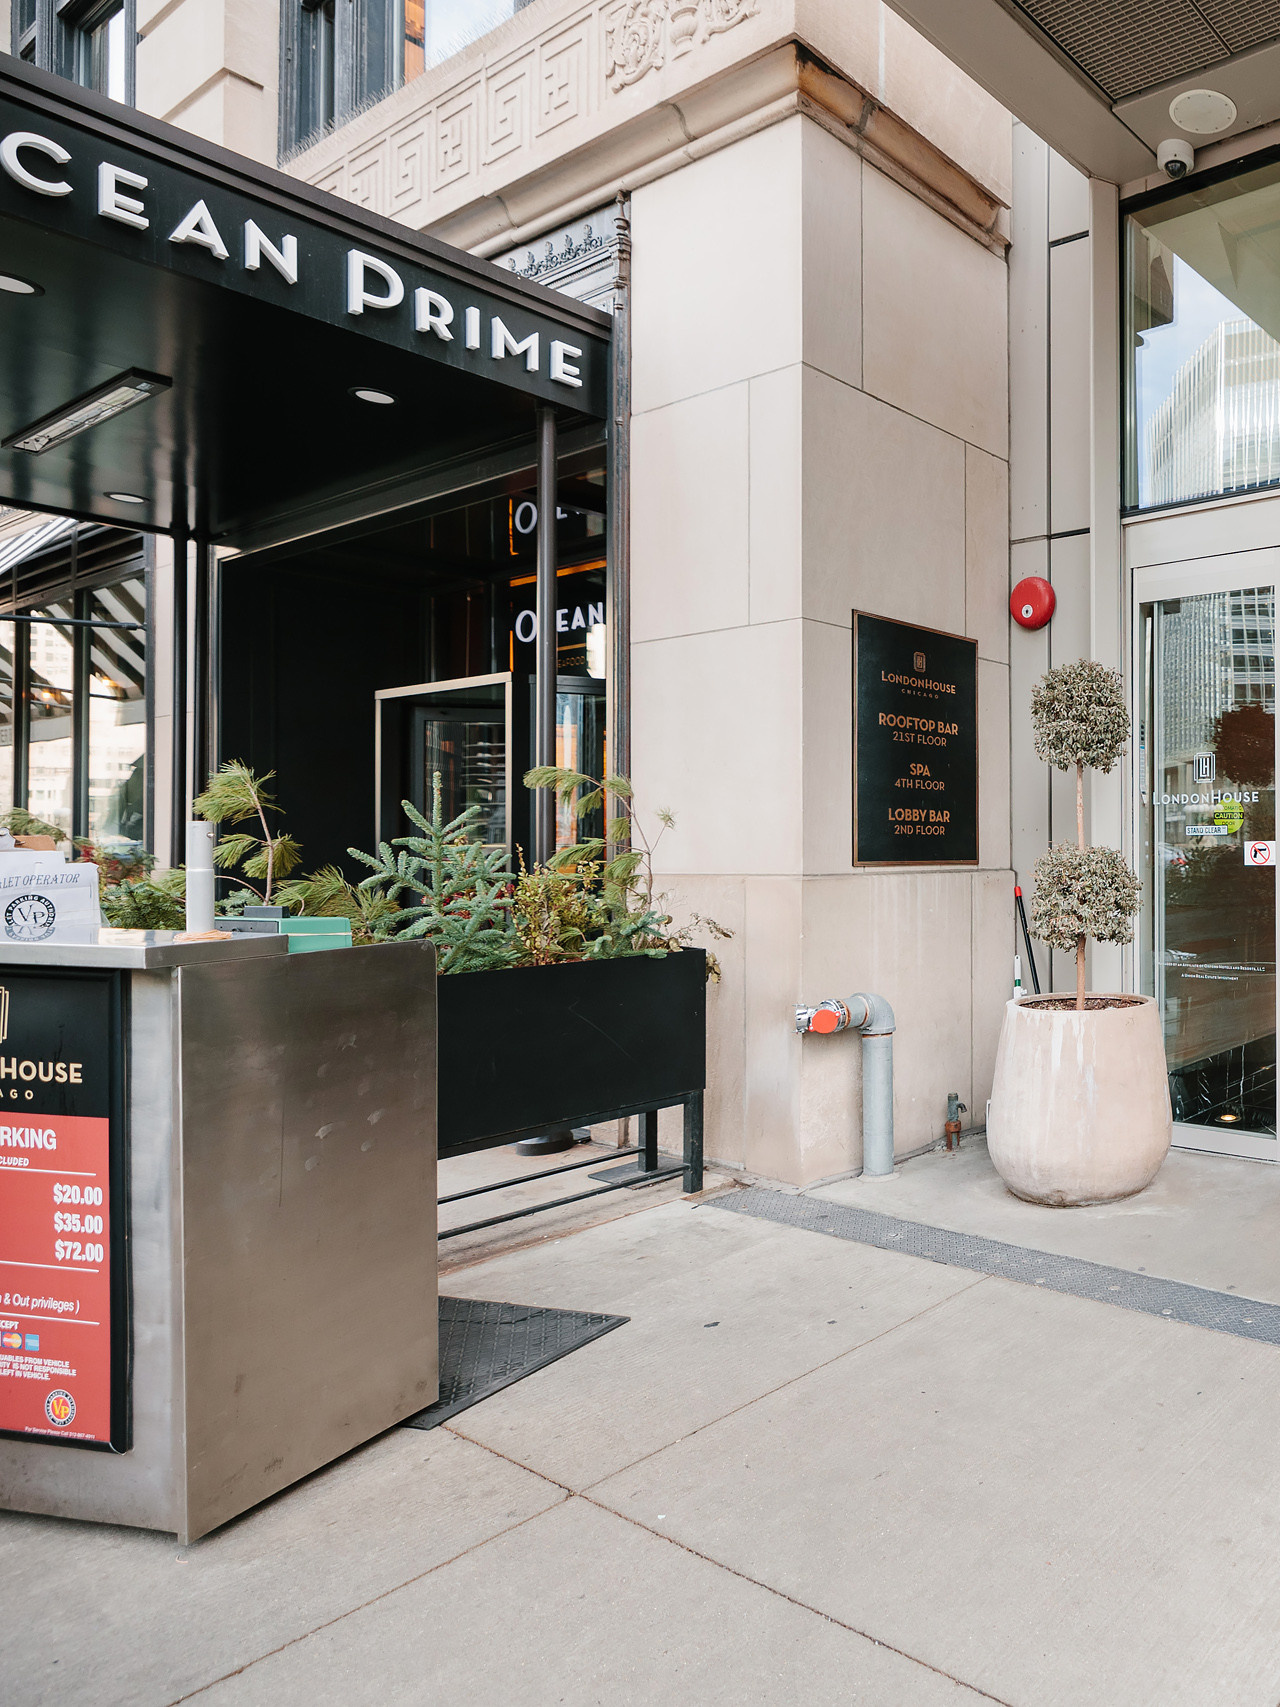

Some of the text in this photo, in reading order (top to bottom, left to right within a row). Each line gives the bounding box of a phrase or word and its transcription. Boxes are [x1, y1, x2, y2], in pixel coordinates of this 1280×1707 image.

[0, 130, 584, 389] CEAN PRIME
[515, 602, 604, 643] OEAN
[557, 655, 585, 668] EAFOOD
[881, 670, 957, 694] LONDONHOUSE
[901, 688, 939, 699] CHICAGO
[878, 712, 959, 736] ROOFTOP BAR
[892, 730, 947, 747] 21ST FLOOR
[909, 763, 931, 777] SPA
[894, 778, 945, 791] 4TH FLOOR
[1152, 789, 1259, 805] LONDONHOUSE
[888, 807, 950, 823] LOBBY BAR
[894, 824, 946, 836] 2ND FLOOR
[22, 873, 80, 887] OPERATOR
[53, 1182, 103, 1206] $20.00
[54, 1210, 104, 1234] $35.00
[55, 1238, 104, 1263] $72.00
[4, 1293, 11, 1305] &
[12, 1293, 30, 1306] Out
[31, 1296, 74, 1313] privileges
[44, 1359, 70, 1368] VEHICLE
